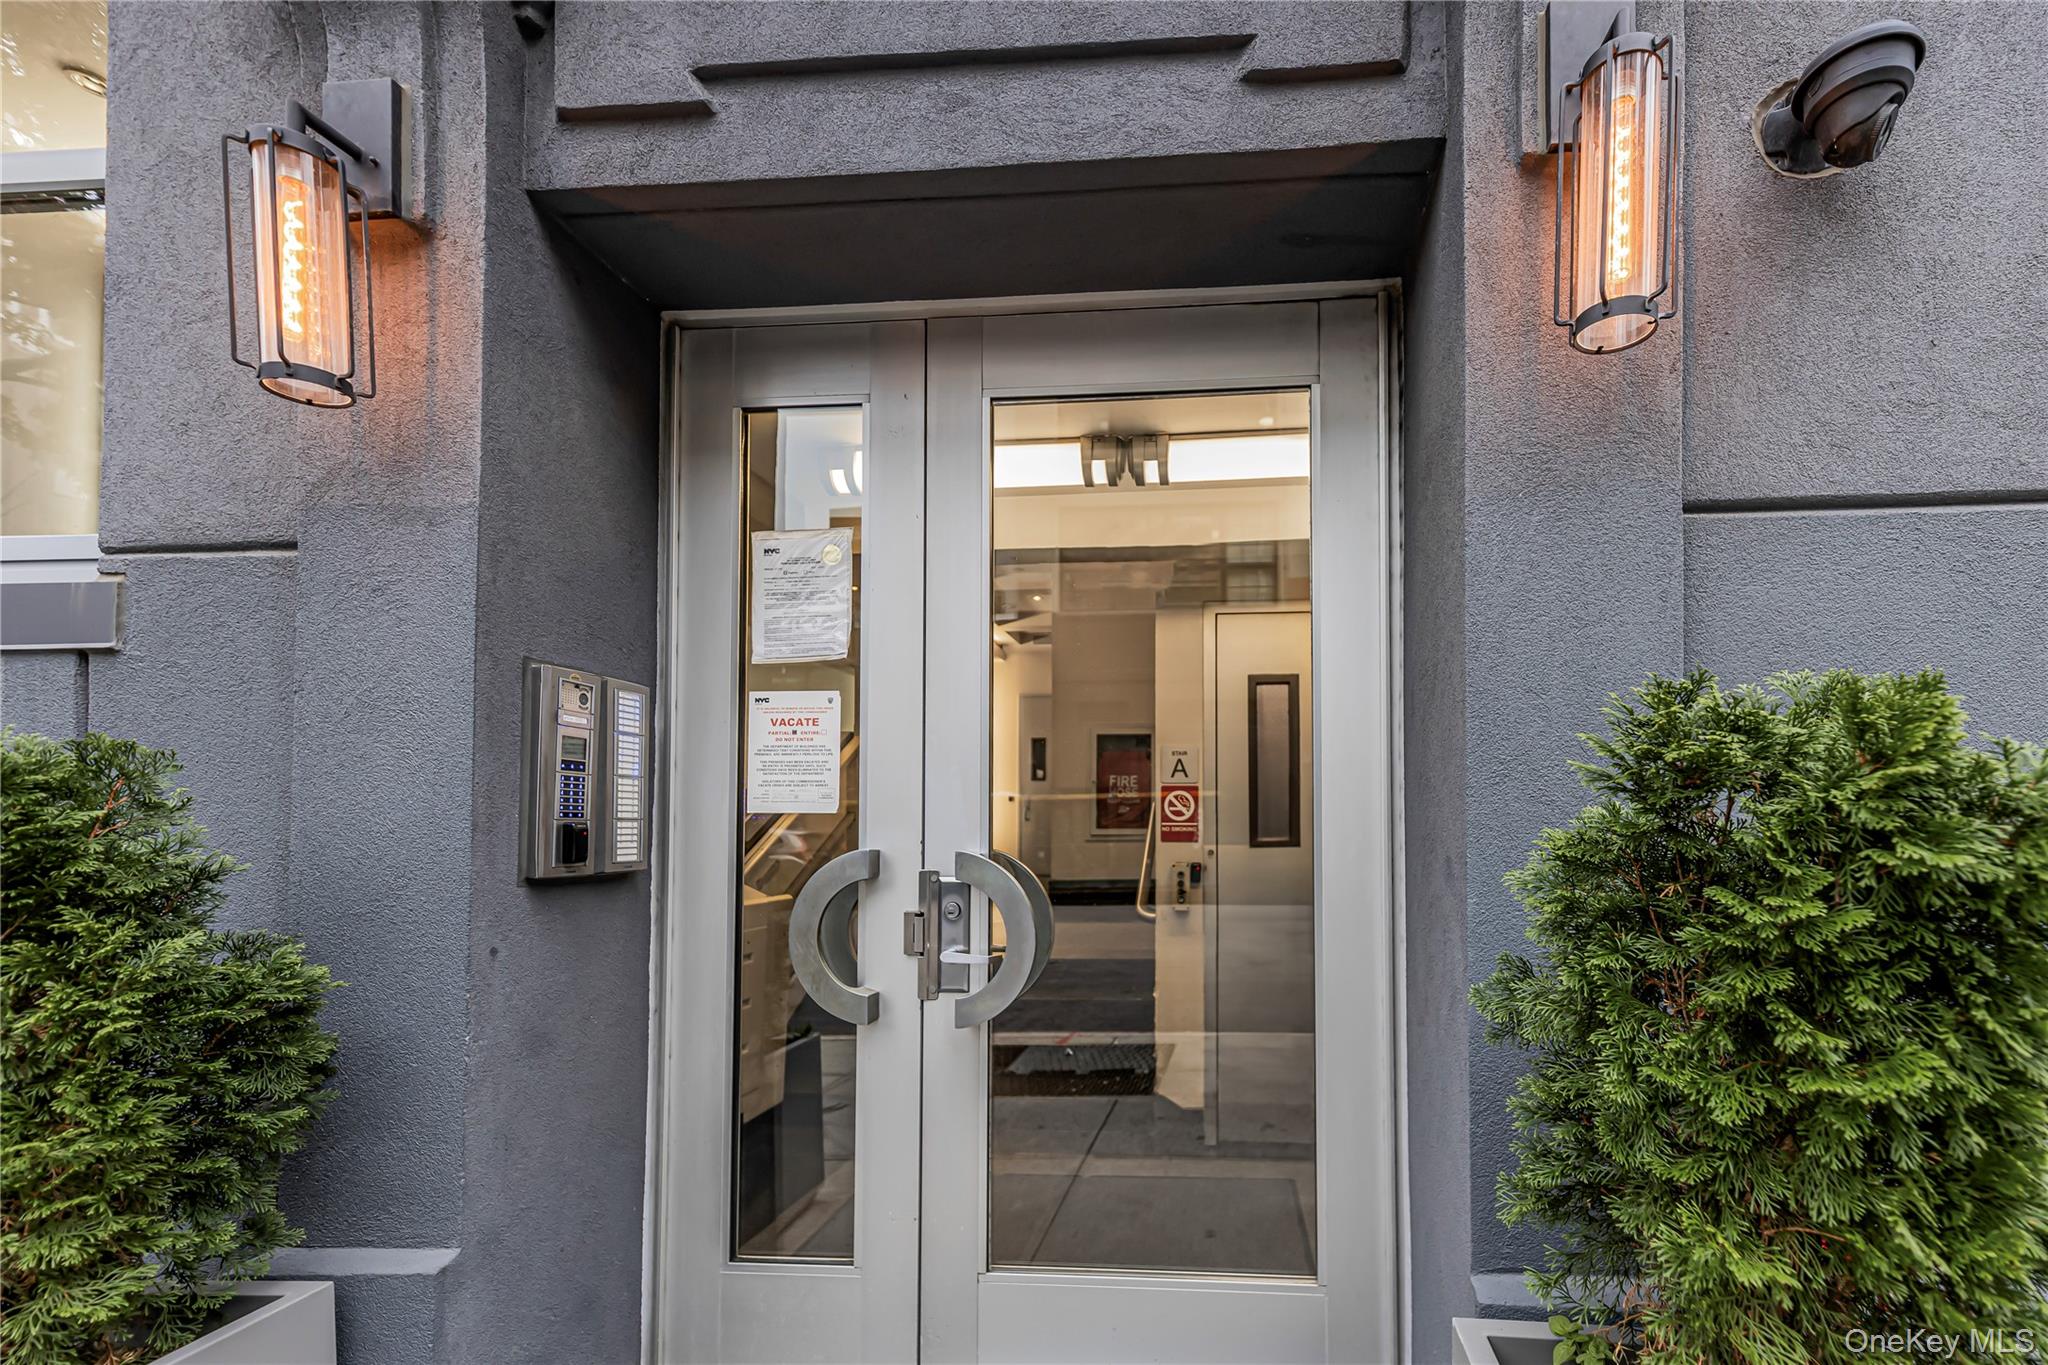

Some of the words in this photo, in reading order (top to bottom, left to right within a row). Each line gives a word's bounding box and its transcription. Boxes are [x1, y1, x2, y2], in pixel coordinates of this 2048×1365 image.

[770, 718, 820, 726] VACATE
[1170, 758, 1188, 778] A
[1110, 775, 1138, 786] FIRE
